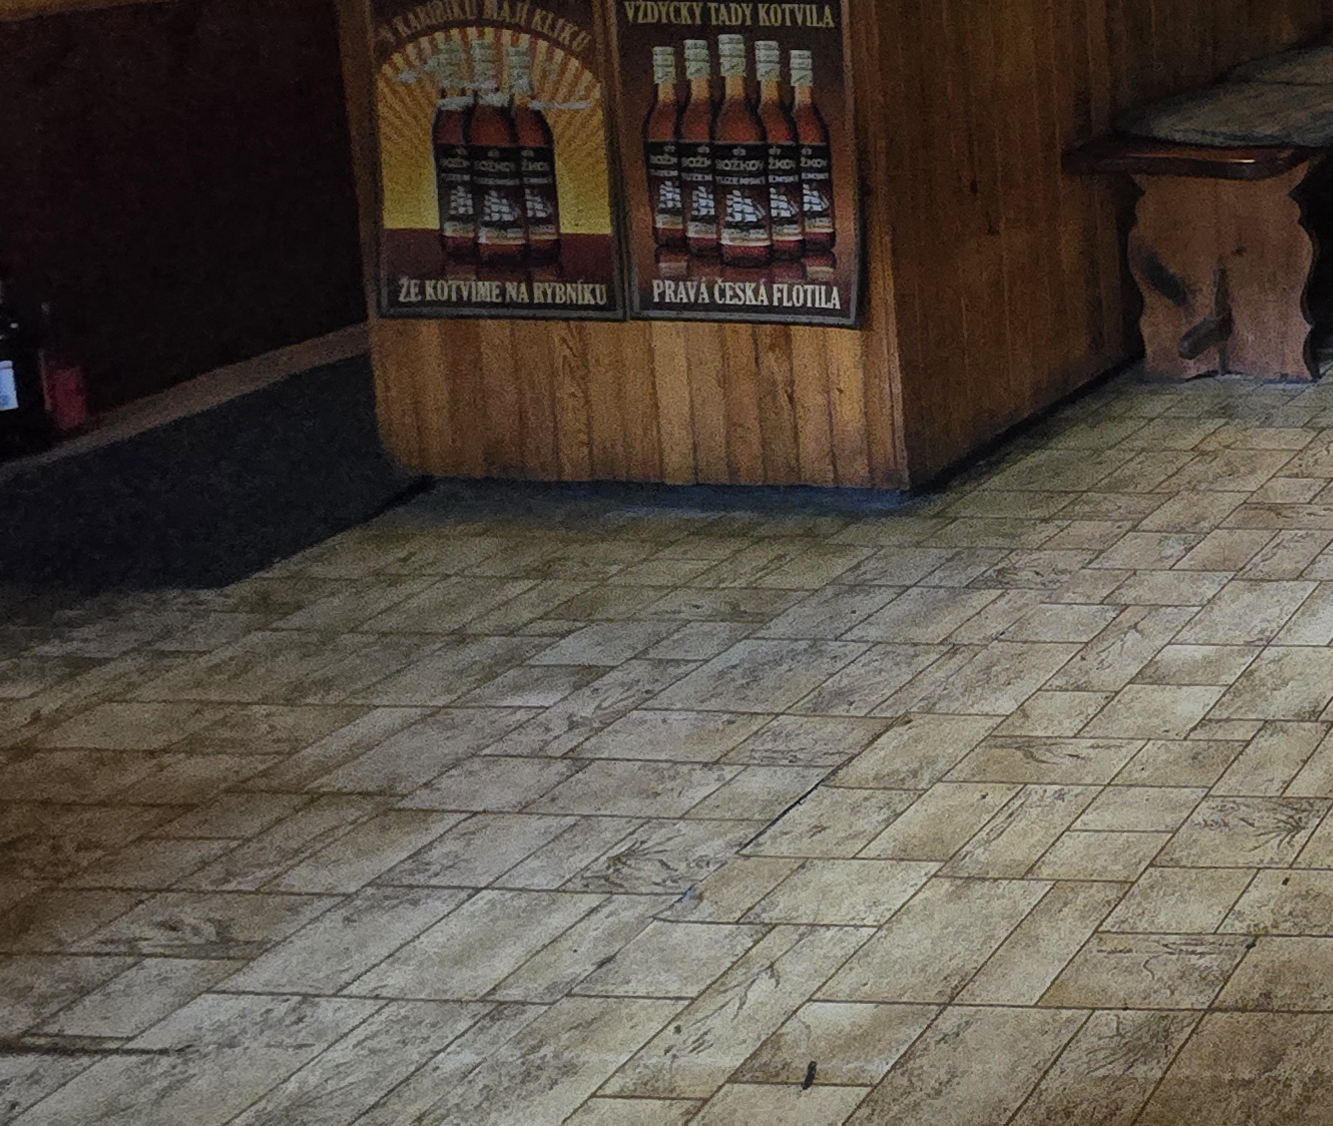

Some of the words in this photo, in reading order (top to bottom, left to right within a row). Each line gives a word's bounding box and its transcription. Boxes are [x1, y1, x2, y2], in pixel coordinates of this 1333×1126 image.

[707, 1, 754, 26] TADY
[757, 2, 836, 28] KOTVILA
[397, 275, 423, 303] ŽE
[424, 276, 504, 304] KOTVÍME
[504, 282, 530, 304] NA
[532, 278, 608, 306] RYBNÍKU
[651, 276, 711, 304] PRAVÁ
[713, 277, 769, 307] ČESKÁ
[772, 283, 842, 310] FLOTILA
